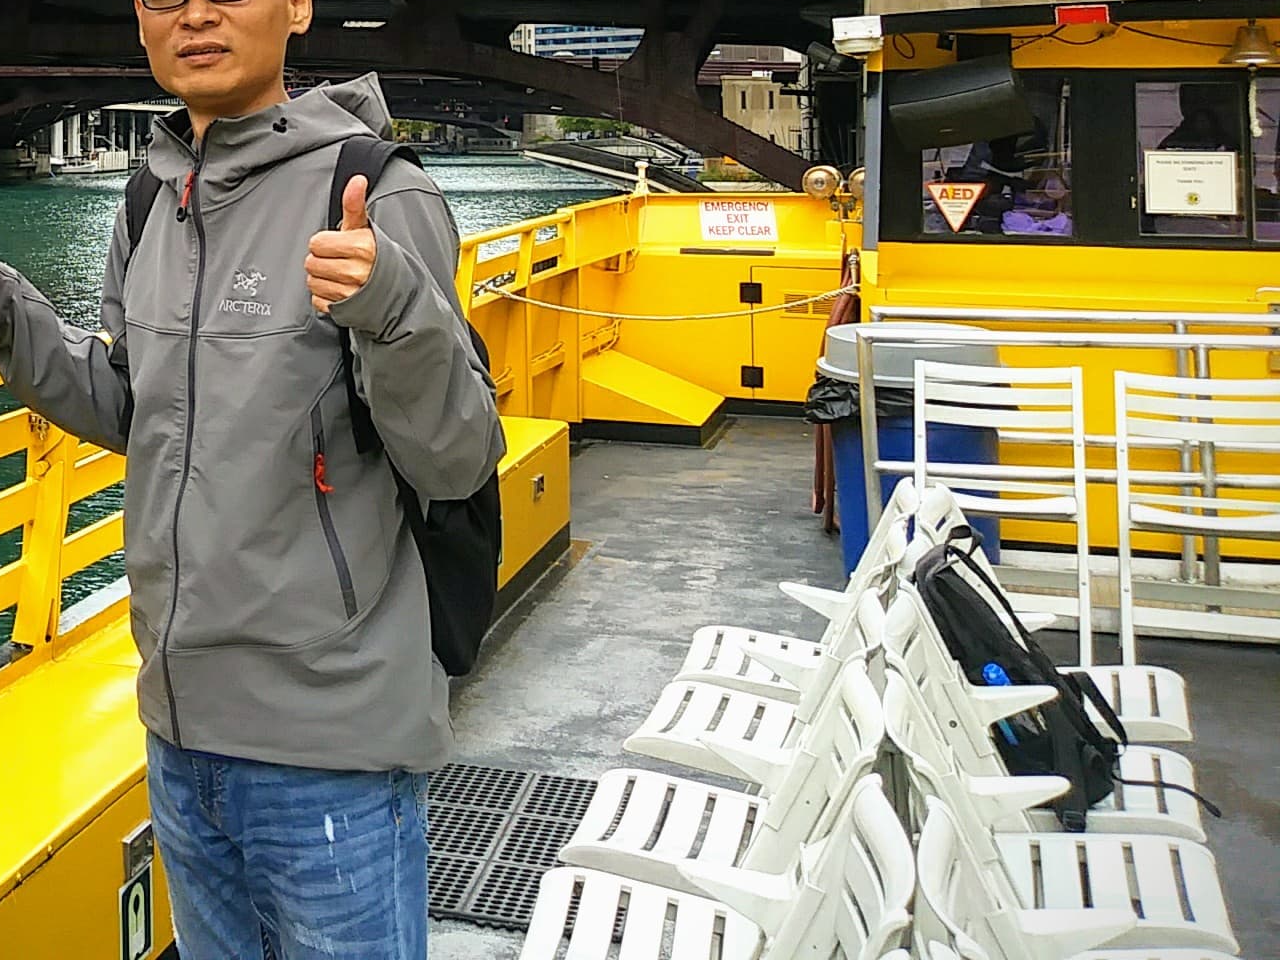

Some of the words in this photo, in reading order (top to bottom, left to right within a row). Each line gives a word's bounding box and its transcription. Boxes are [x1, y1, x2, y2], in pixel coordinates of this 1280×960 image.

[939, 188, 974, 200] AED
[704, 201, 769, 212] EMERGENCY
[726, 213, 749, 223] EXIT
[708, 225, 735, 236] KEEP
[737, 225, 771, 236] CLEAR
